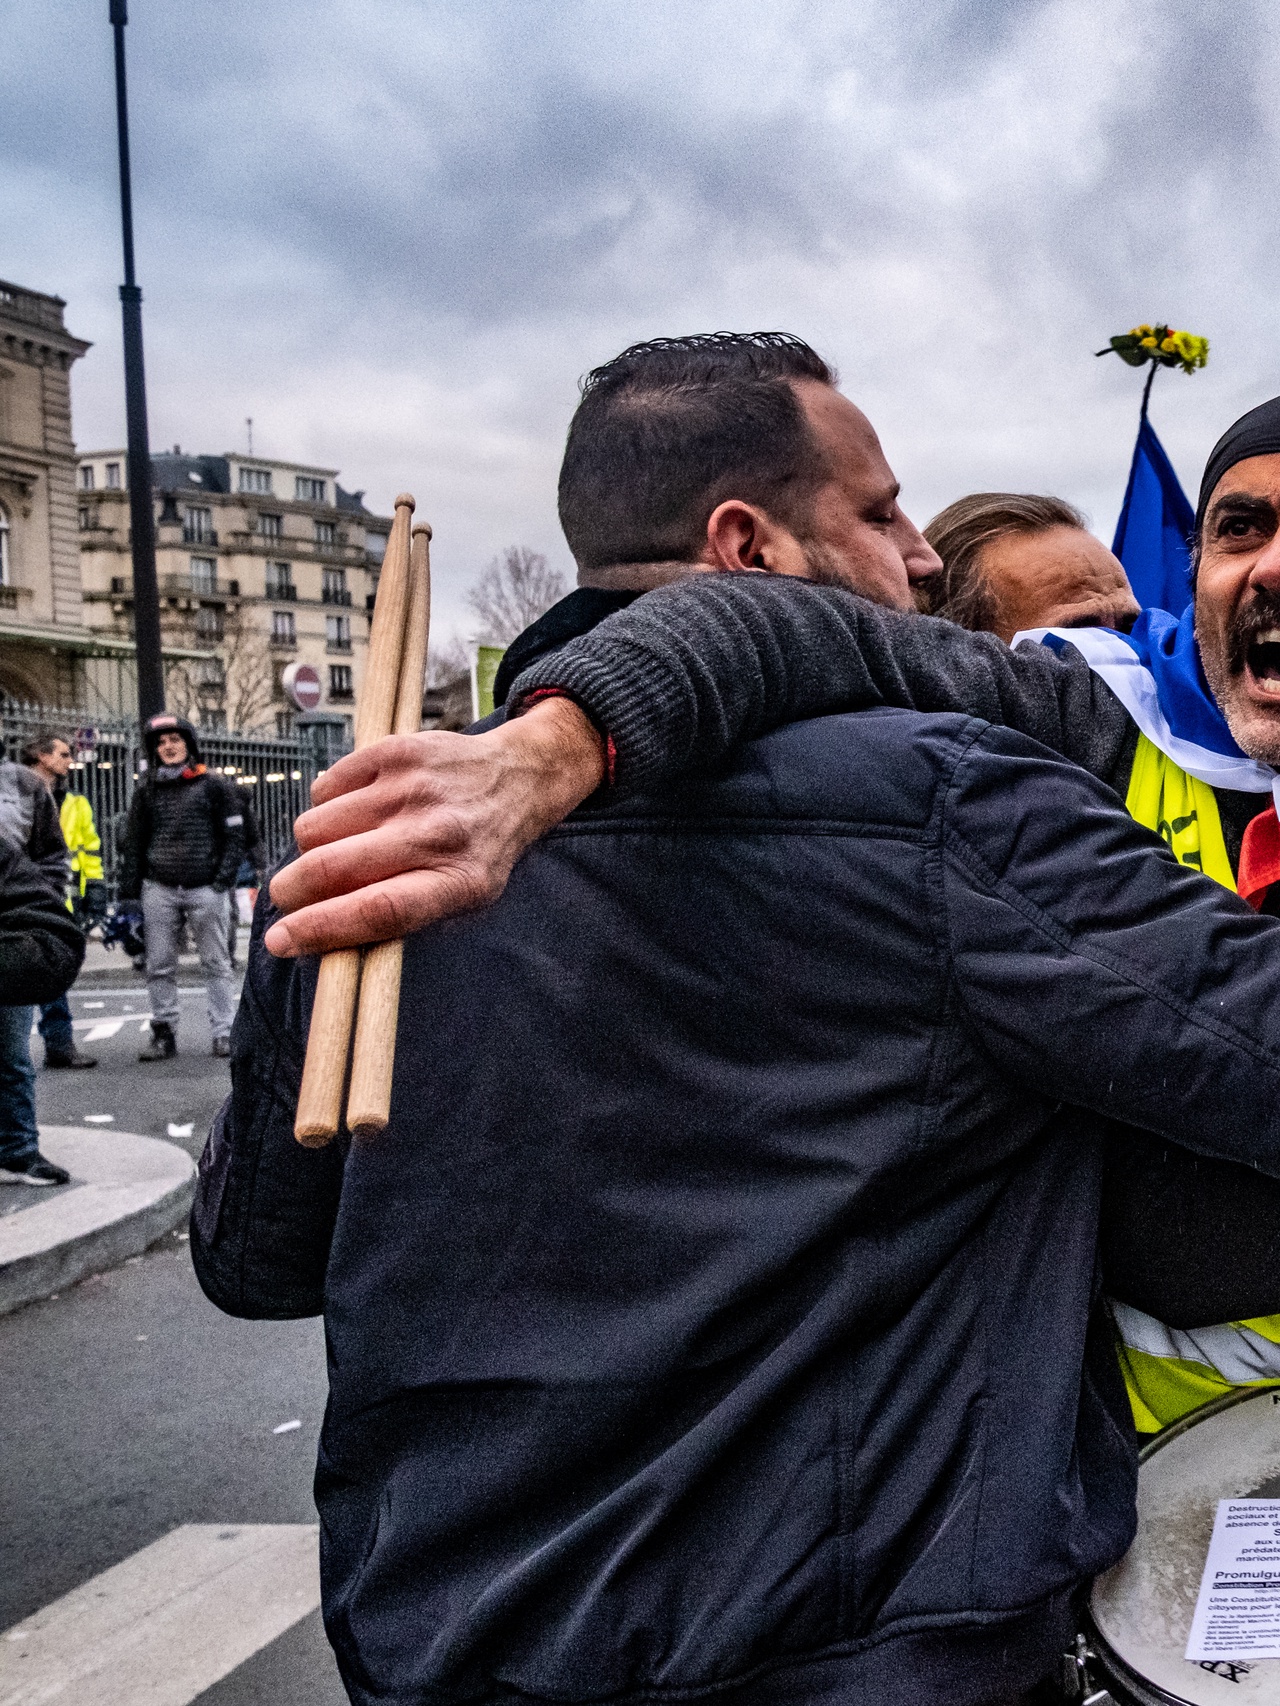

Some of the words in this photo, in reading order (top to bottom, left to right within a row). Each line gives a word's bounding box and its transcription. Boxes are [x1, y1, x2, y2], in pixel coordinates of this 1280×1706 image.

[1226, 1512, 1266, 1520] sociaux
[1225, 1520, 1270, 1528] absence
[1207, 1604, 1248, 1612] citoyens
